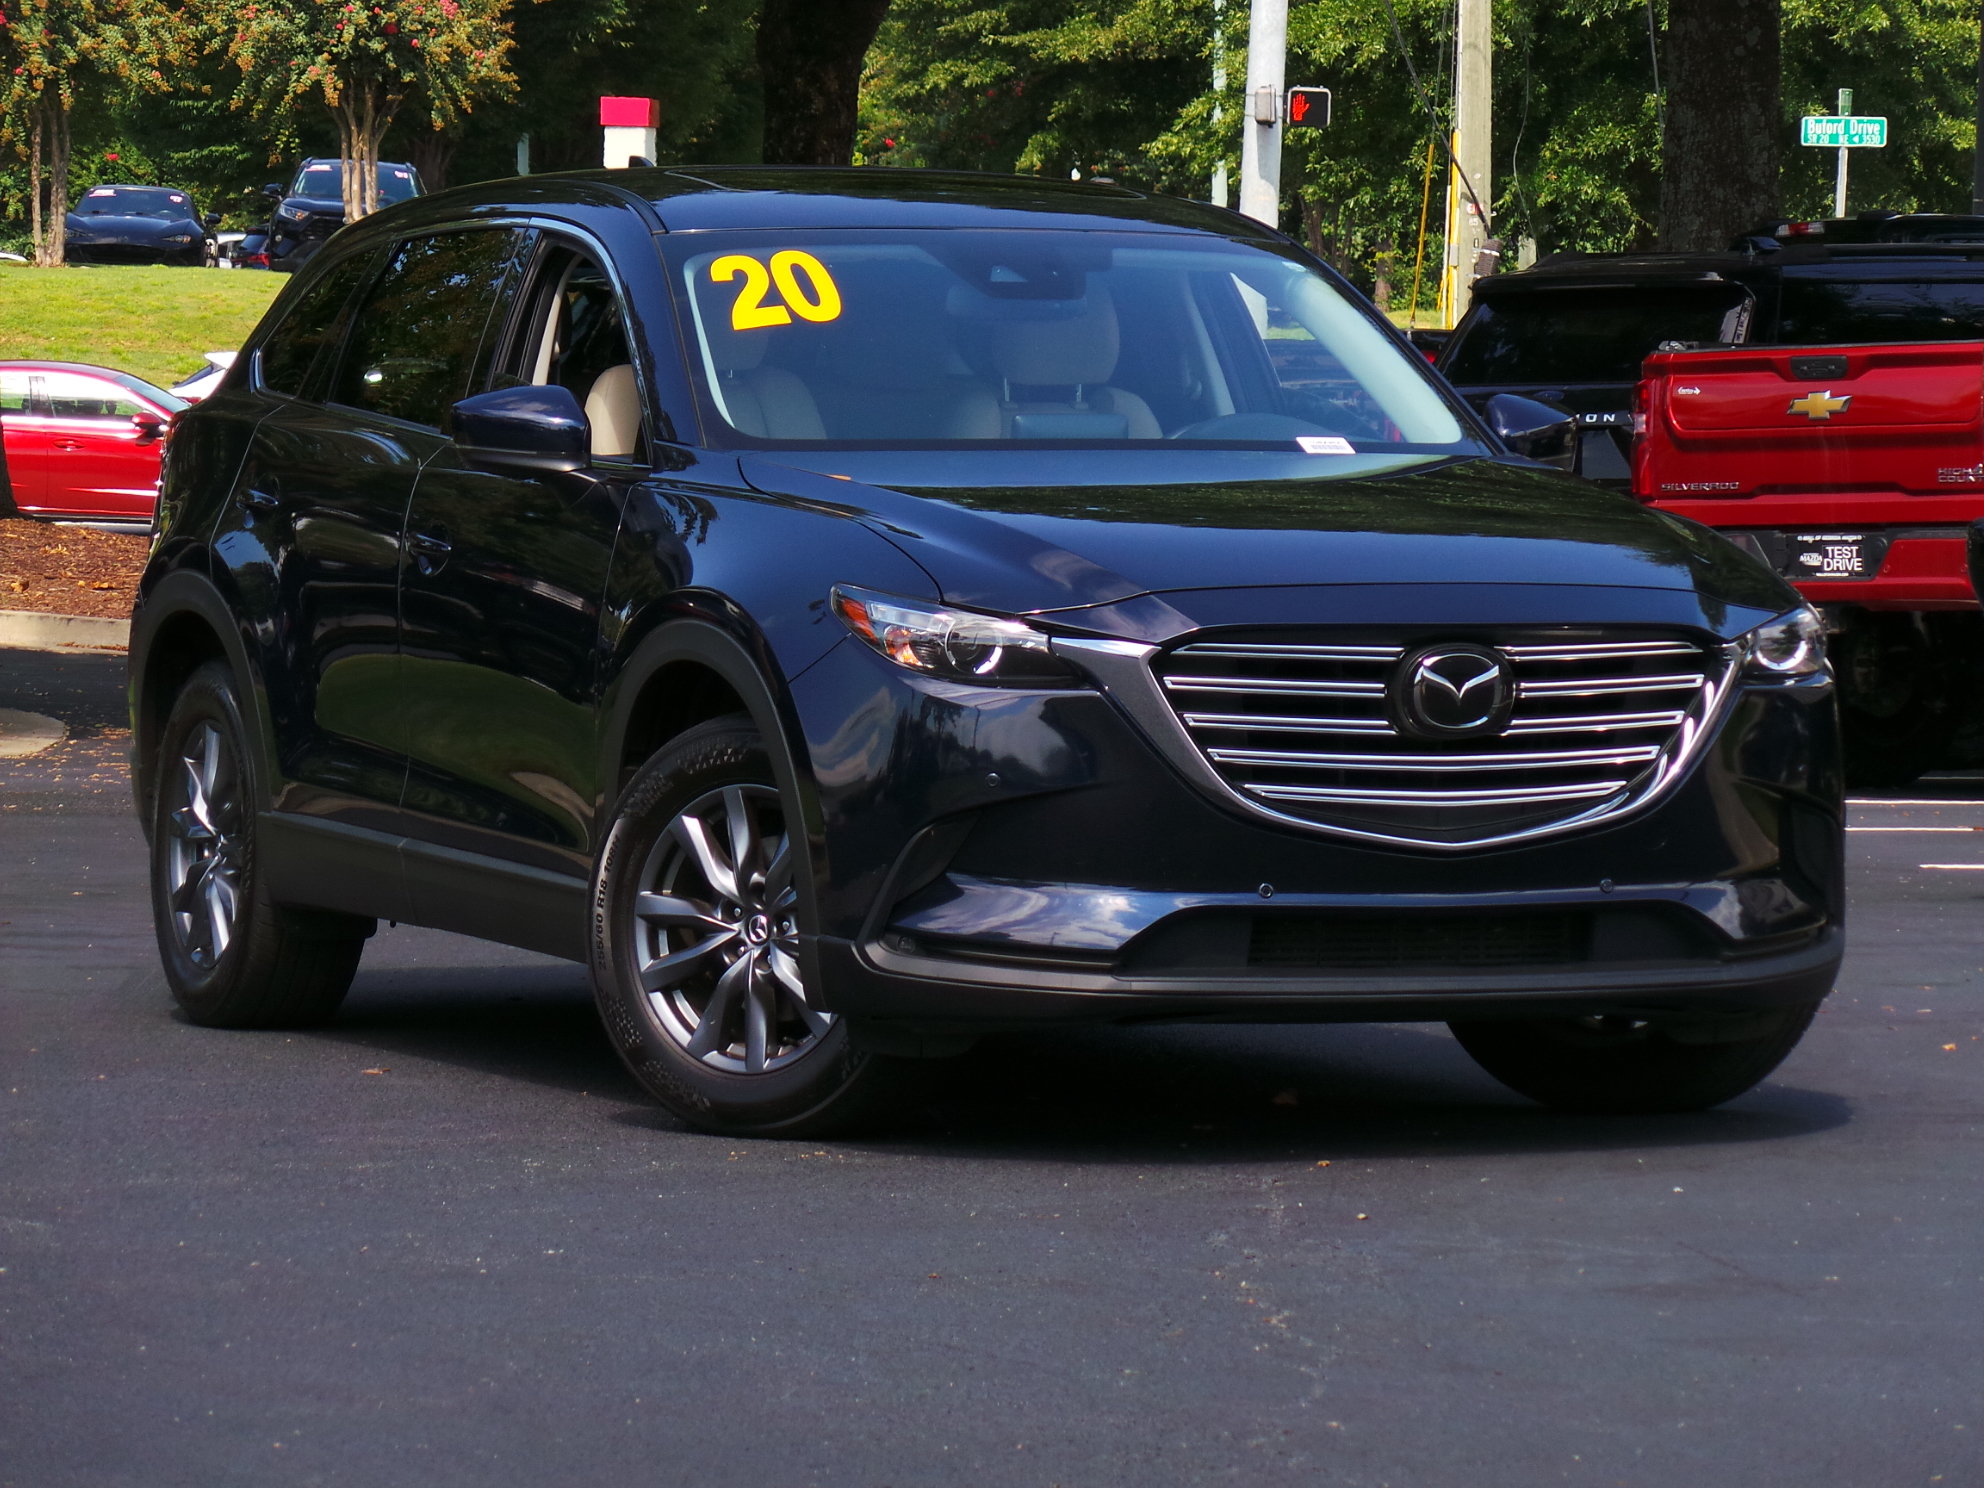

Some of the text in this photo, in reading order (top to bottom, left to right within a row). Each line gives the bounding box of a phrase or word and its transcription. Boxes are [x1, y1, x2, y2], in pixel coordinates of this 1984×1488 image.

[1807, 119, 1880, 134] Buford Drive
[1807, 134, 1817, 144] SR
[1819, 134, 1829, 144] 20
[709, 249, 842, 331] 20
[1661, 482, 1739, 491] SILVERADO
[1825, 546, 1859, 559] TEST
[1823, 558, 1863, 571] DRIVE
[596, 878, 608, 909] R18
